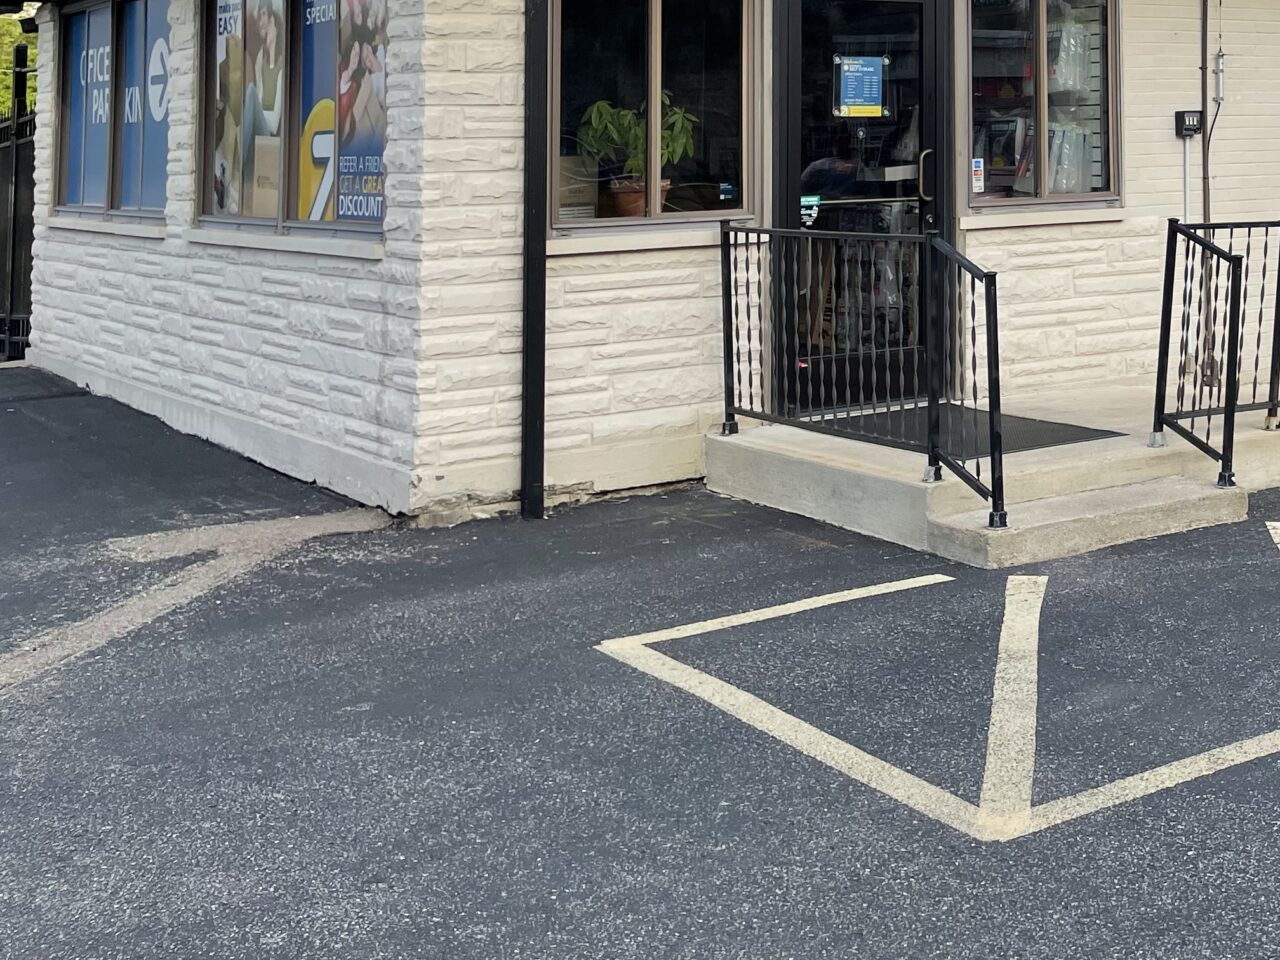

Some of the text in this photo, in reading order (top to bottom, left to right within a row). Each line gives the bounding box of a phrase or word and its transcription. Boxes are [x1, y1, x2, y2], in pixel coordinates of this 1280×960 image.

[218, 14, 239, 36] EASY
[79, 45, 110, 86] OFICE
[339, 155, 357, 173] REFER
[358, 155, 364, 173] A
[339, 175, 354, 193] GET
[362, 175, 384, 194] GREA
[338, 195, 383, 217] DISCOUNT
